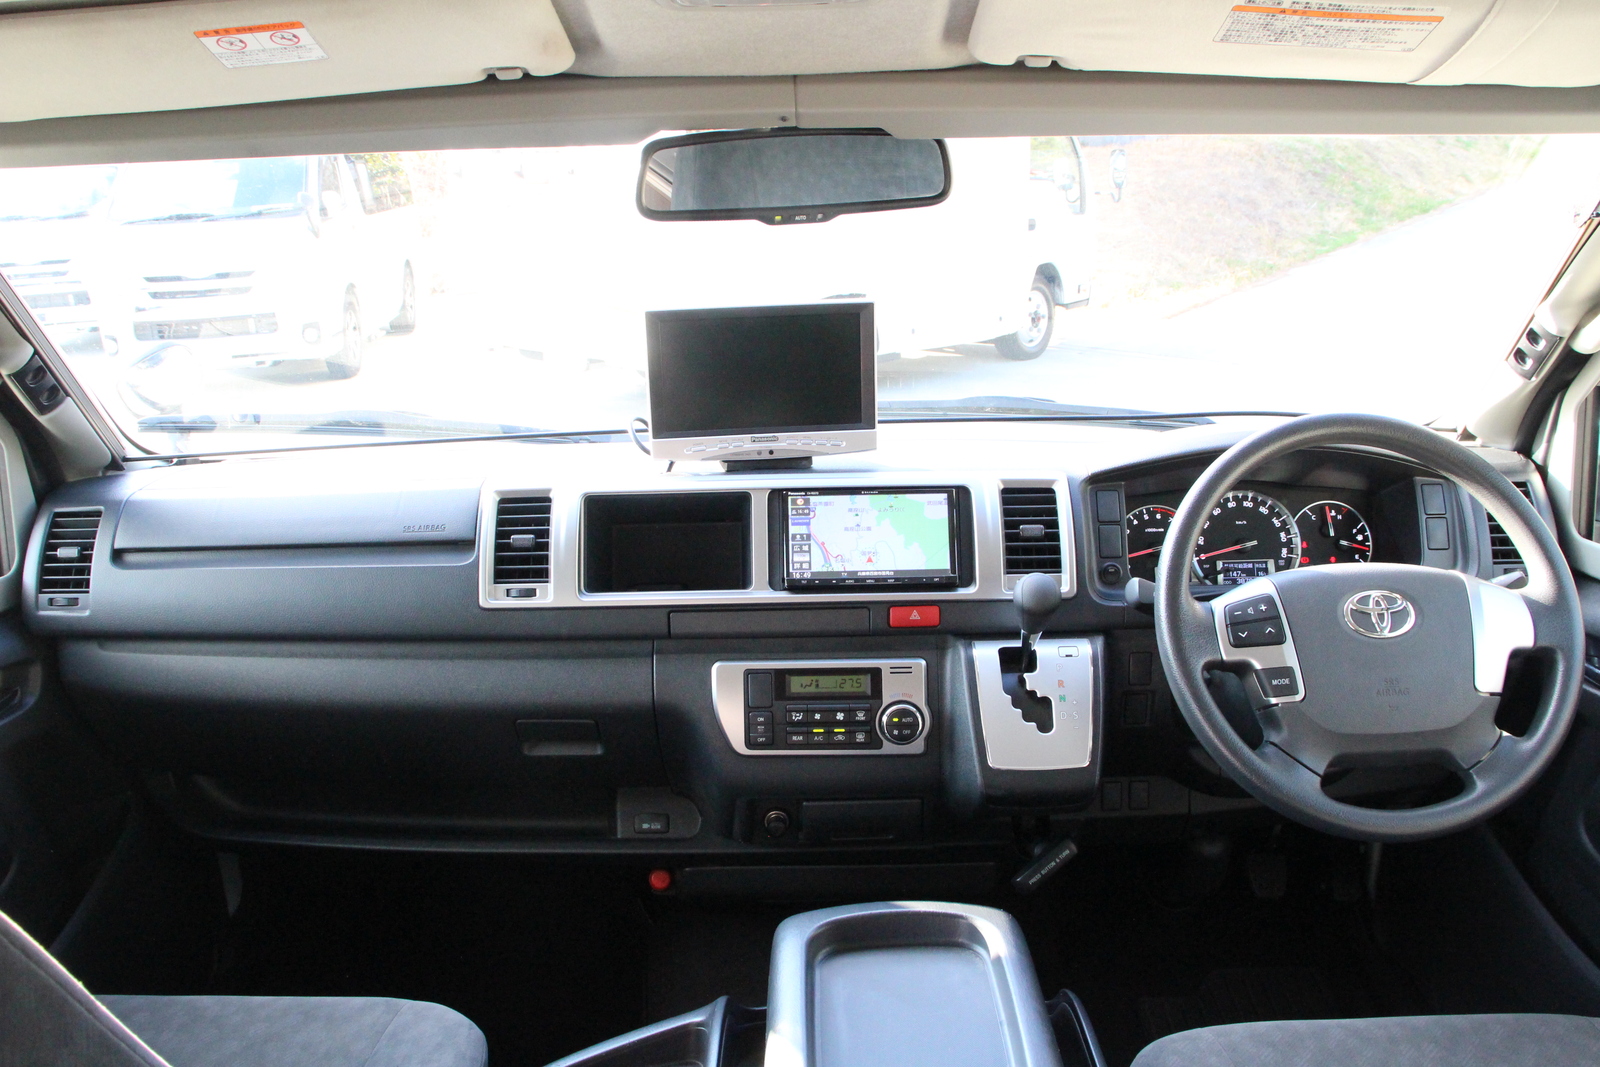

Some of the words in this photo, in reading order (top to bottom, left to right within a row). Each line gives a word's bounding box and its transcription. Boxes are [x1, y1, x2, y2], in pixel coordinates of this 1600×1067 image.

[1212, 508, 1222, 516] 60
[1258, 506, 1269, 515] 120
[1272, 516, 1281, 528] 140
[1280, 531, 1288, 542] 160
[1056, 663, 1063, 672] P
[1058, 680, 1066, 688] R
[1384, 677, 1400, 686] SRS
[1376, 688, 1410, 697] AIRBAG
[1058, 694, 1066, 702] N
[1060, 711, 1068, 720] D
[1072, 711, 1079, 720] S
[1028, 873, 1042, 885] PRESS
[1041, 860, 1056, 876] BUTTON
[1059, 848, 1070, 860] TURN
